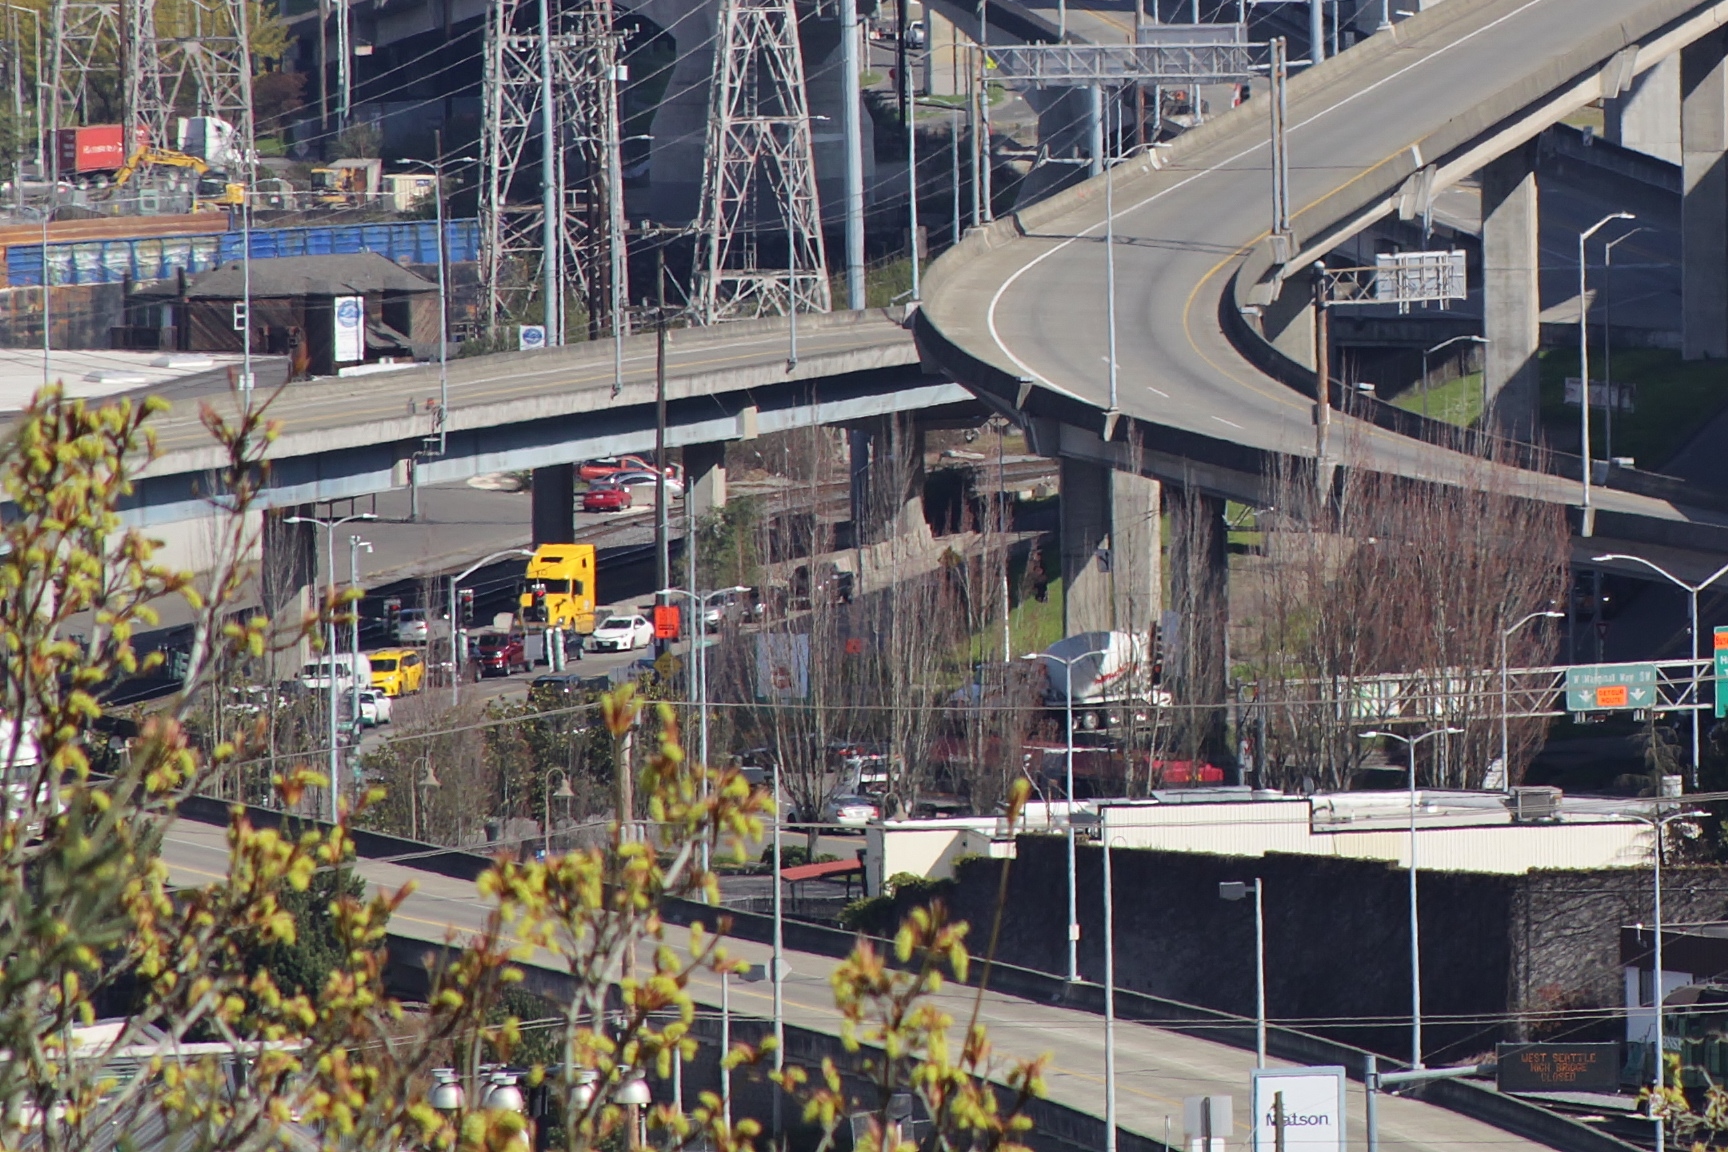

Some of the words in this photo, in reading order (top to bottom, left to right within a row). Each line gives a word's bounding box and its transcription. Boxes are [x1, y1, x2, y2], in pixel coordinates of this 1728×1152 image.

[1619, 673, 1634, 684] Way
[1521, 1052, 1547, 1063] WEST
[1552, 1052, 1596, 1063] SEATTLE
[1530, 1062, 1551, 1072] HIGH
[1556, 1062, 1587, 1072] BRIDGE
[1541, 1072, 1576, 1082] CLOSED
